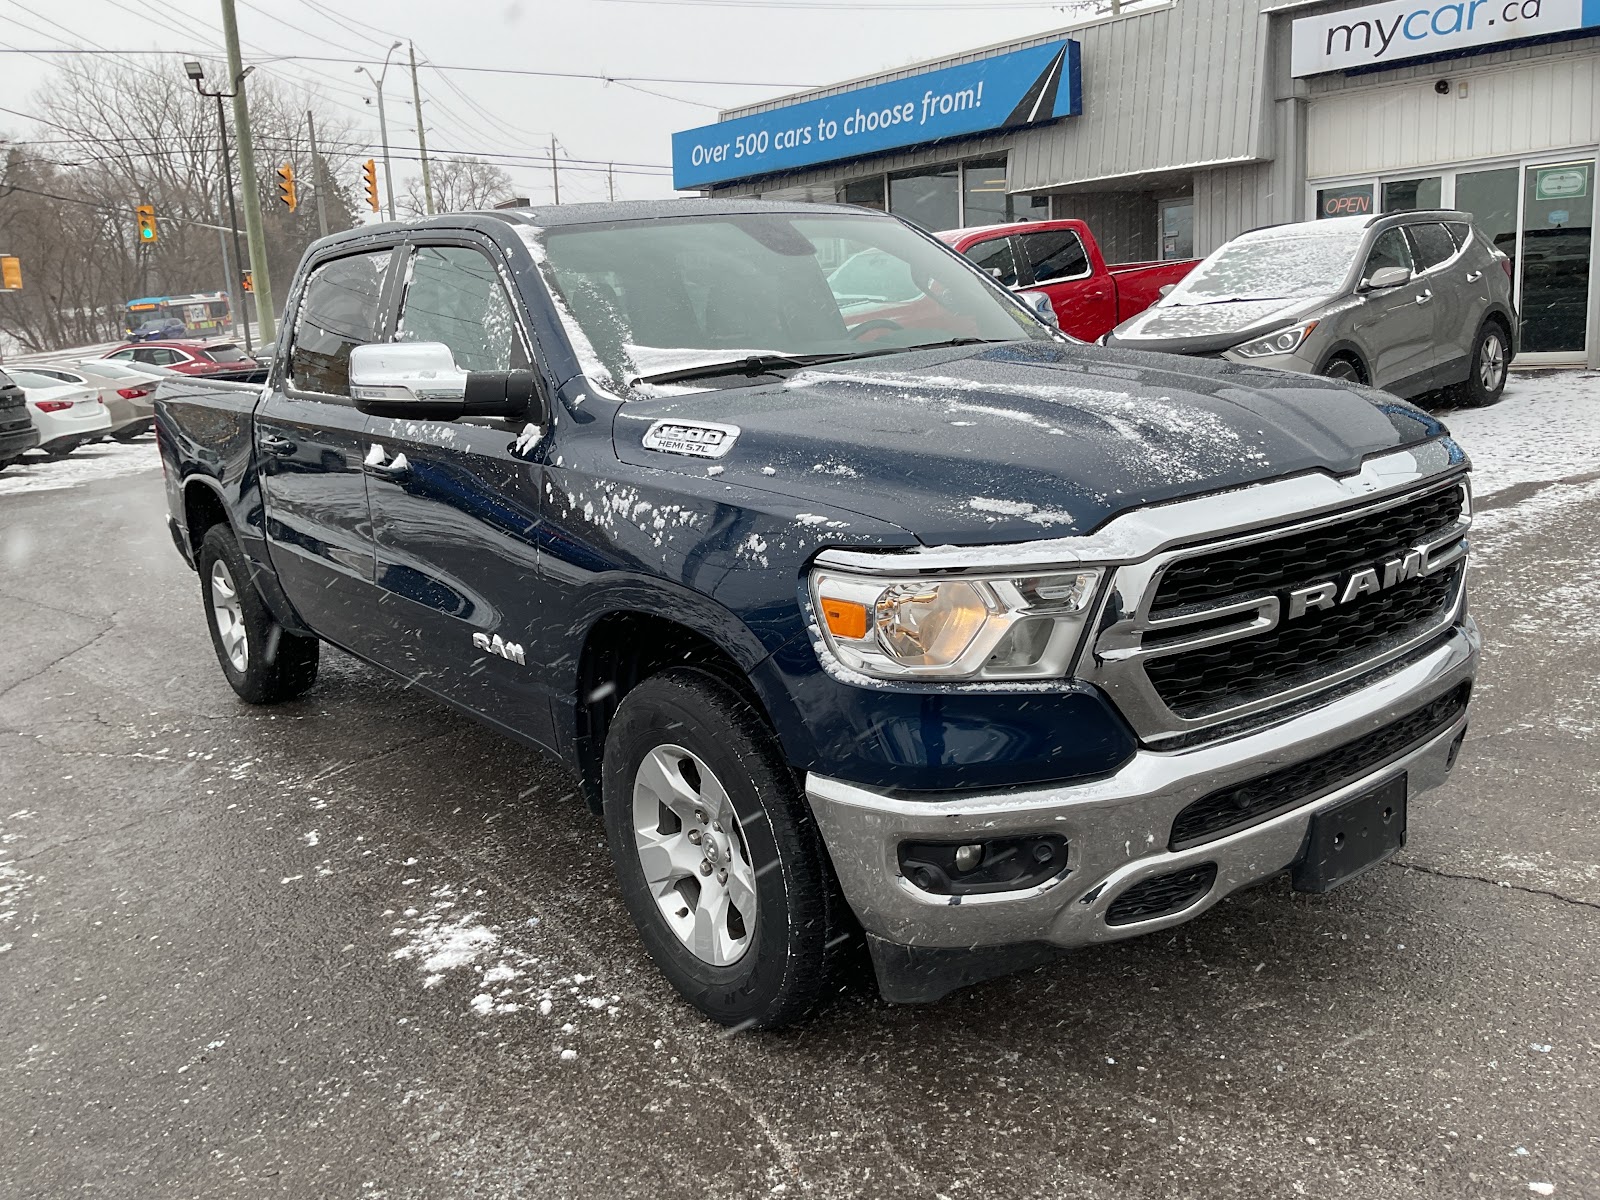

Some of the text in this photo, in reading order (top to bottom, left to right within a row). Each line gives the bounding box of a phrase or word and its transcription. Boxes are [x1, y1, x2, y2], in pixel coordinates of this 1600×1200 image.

[691, 80, 984, 167] Over 500 cars to choose from!
[1325, 196, 1370, 214] OPEN
[654, 425, 725, 446] 1500
[658, 440, 709, 453] HEMI 5.7L
[1288, 551, 1421, 621] RAM
[472, 632, 526, 666] RAM
